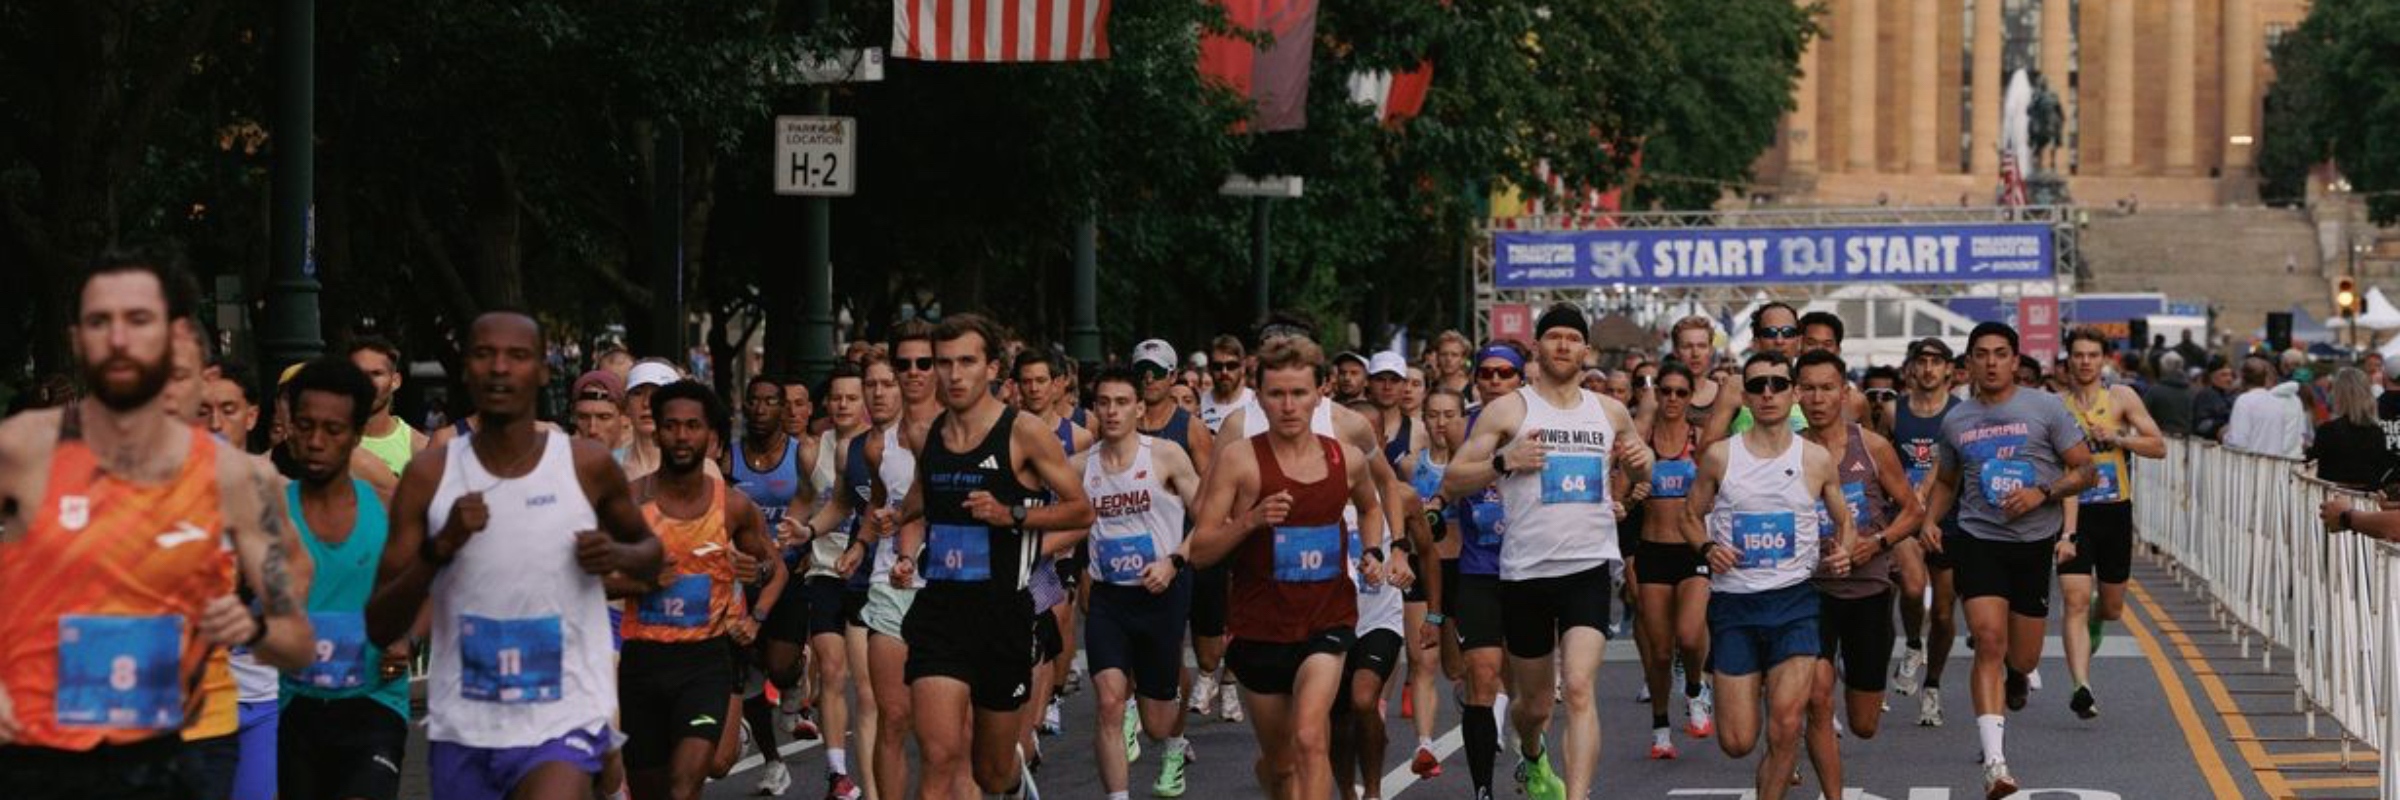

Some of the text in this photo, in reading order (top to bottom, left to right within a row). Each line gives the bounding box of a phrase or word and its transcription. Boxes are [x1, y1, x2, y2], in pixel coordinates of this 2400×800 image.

[786, 134, 843, 145] LOCATION
[791, 151, 838, 187] H-2
[1589, 241, 1643, 278] 5K
[1653, 239, 1768, 277] START
[1844, 235, 1961, 274] START
[1540, 429, 1605, 447] OWER MILER
[1562, 475, 1586, 492] 64
[1661, 475, 1684, 490] 107
[1092, 489, 1151, 510] LEONIA
[1743, 532, 1786, 549] 1506
[945, 550, 962, 570] 61
[1110, 554, 1143, 573] 920
[1300, 549, 1323, 570] 10
[663, 598, 684, 617] 12
[498, 648, 521, 677] 11
[109, 655, 138, 691] 8
